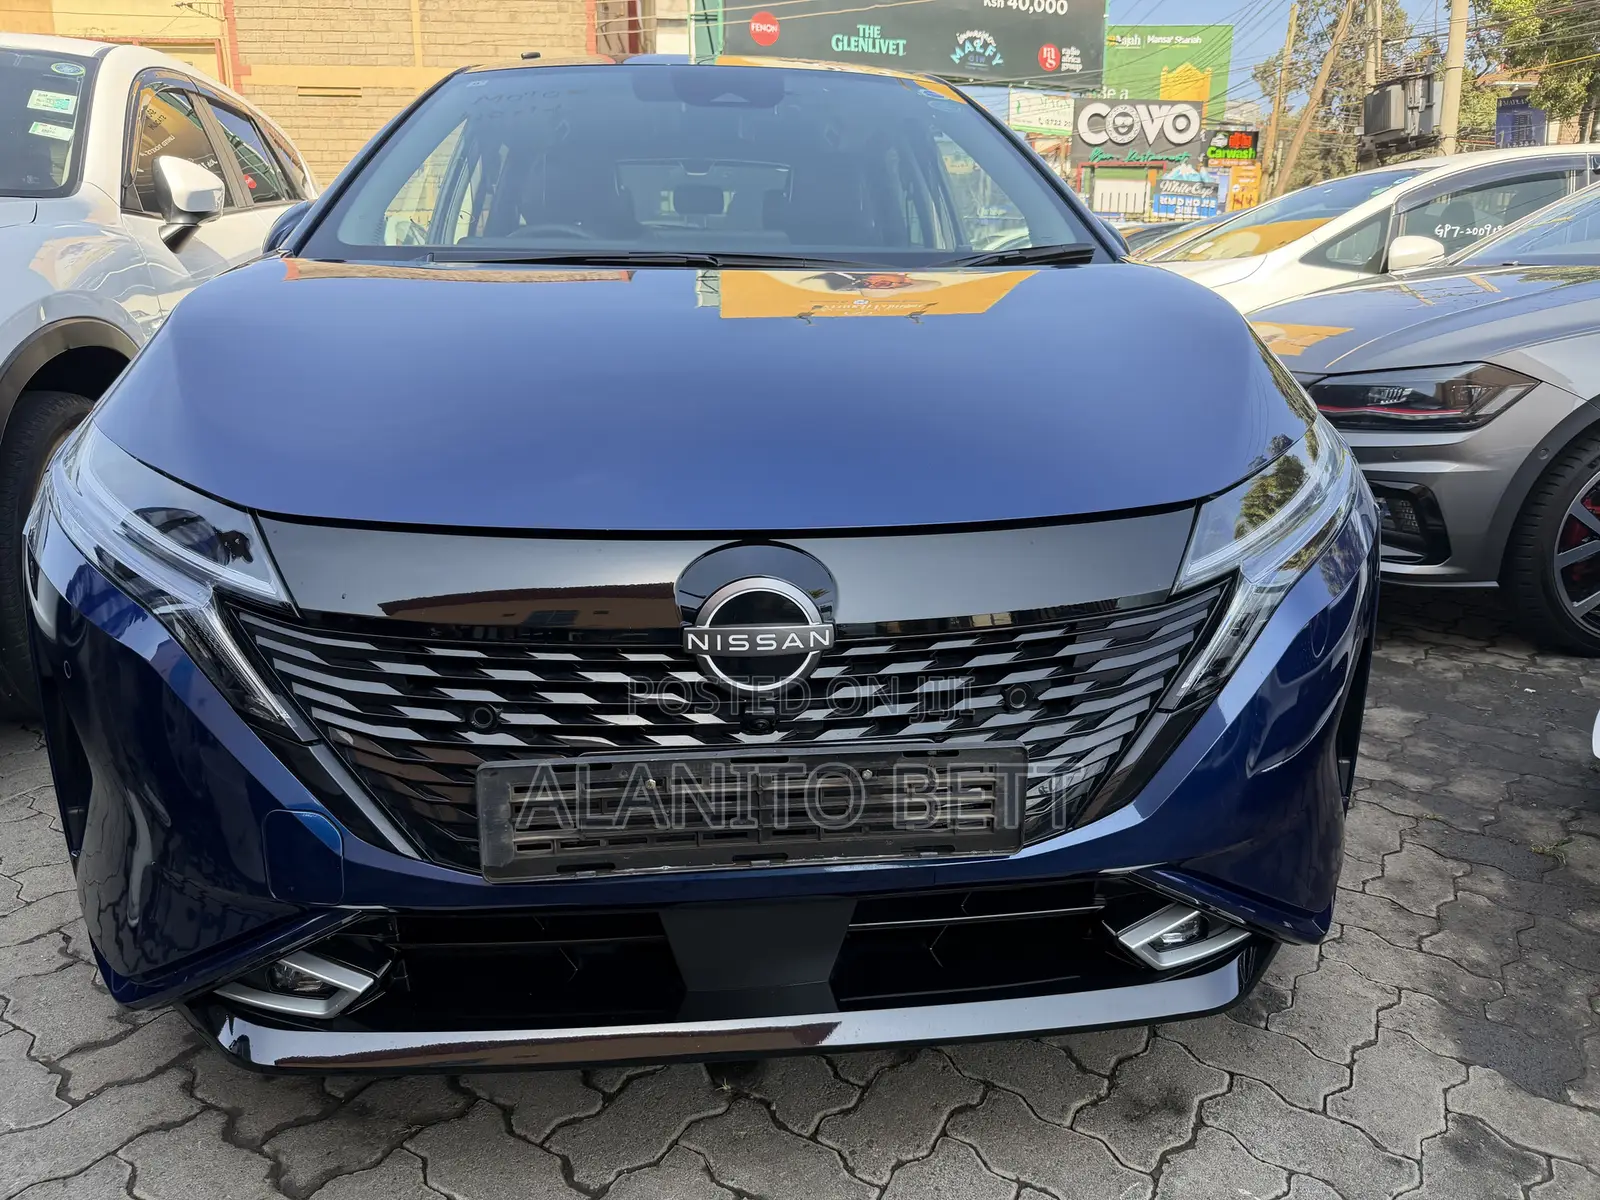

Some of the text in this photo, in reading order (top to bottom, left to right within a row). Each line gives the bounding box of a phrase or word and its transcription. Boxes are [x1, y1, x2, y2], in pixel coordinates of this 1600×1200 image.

[1007, 0, 1069, 15] 40,000
[857, 24, 881, 38] THE
[831, 34, 907, 56] GLENLIVET
[950, 39, 1004, 66] MALFY
[1077, 102, 1200, 145] COVO
[1206, 146, 1256, 159] Carwash
[687, 629, 830, 651] NISSAN
